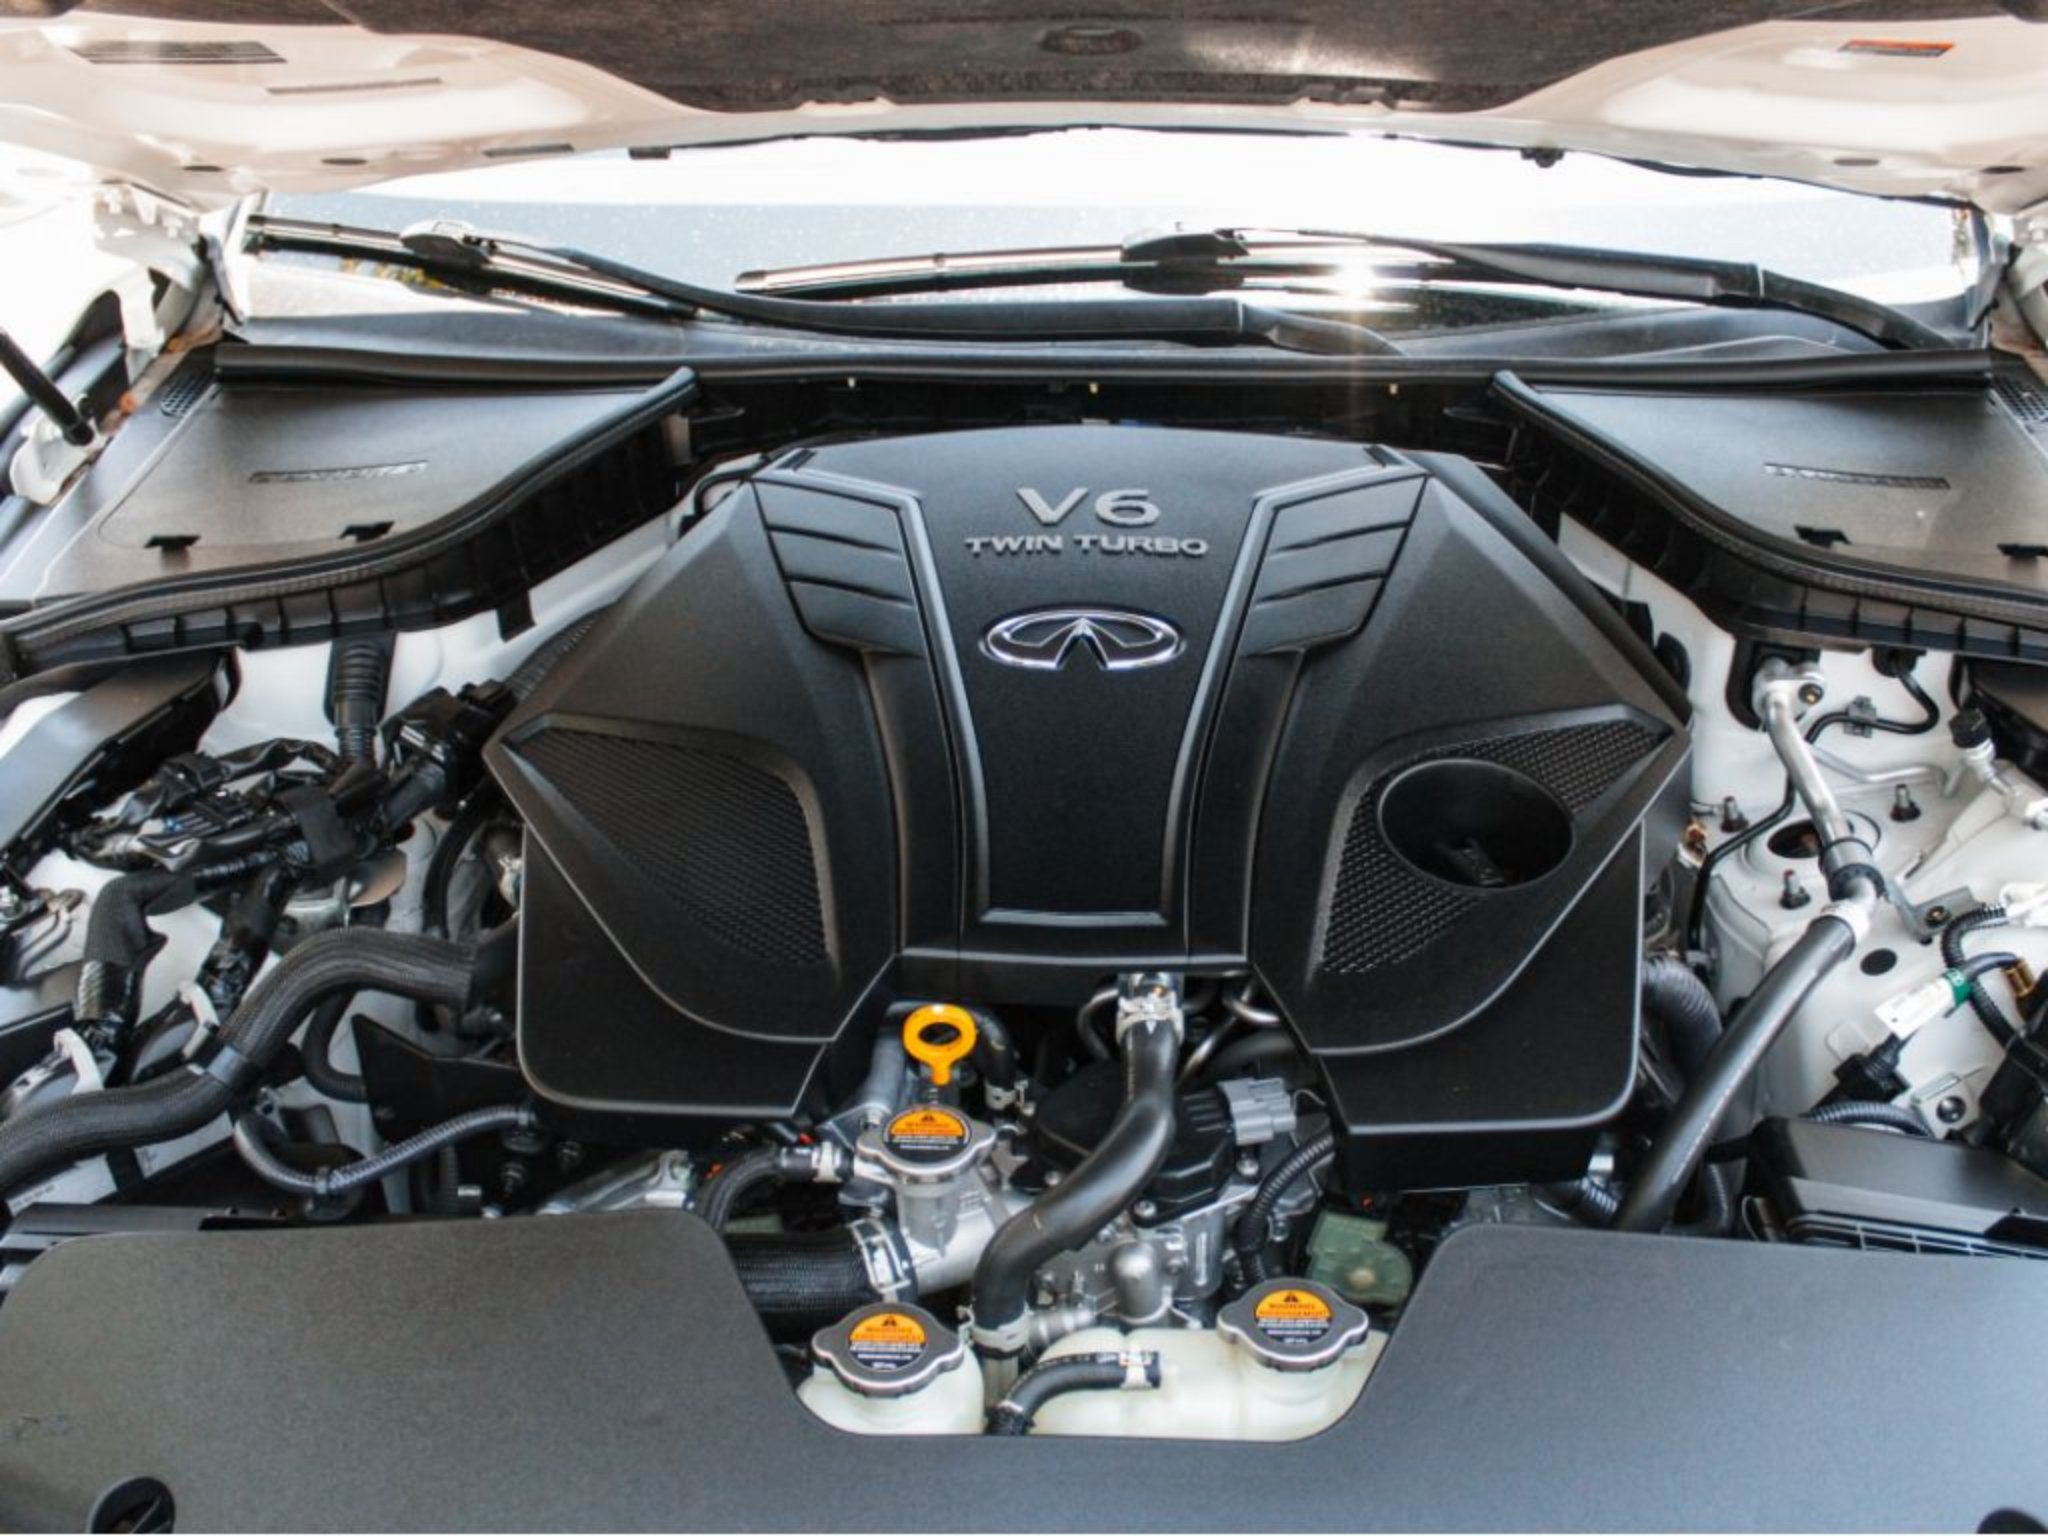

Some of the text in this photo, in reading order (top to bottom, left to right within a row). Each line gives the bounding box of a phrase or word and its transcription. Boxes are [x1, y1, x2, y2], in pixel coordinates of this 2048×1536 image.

[1016, 487, 1160, 527] V6
[965, 534, 1209, 557] TWIN TURBO
